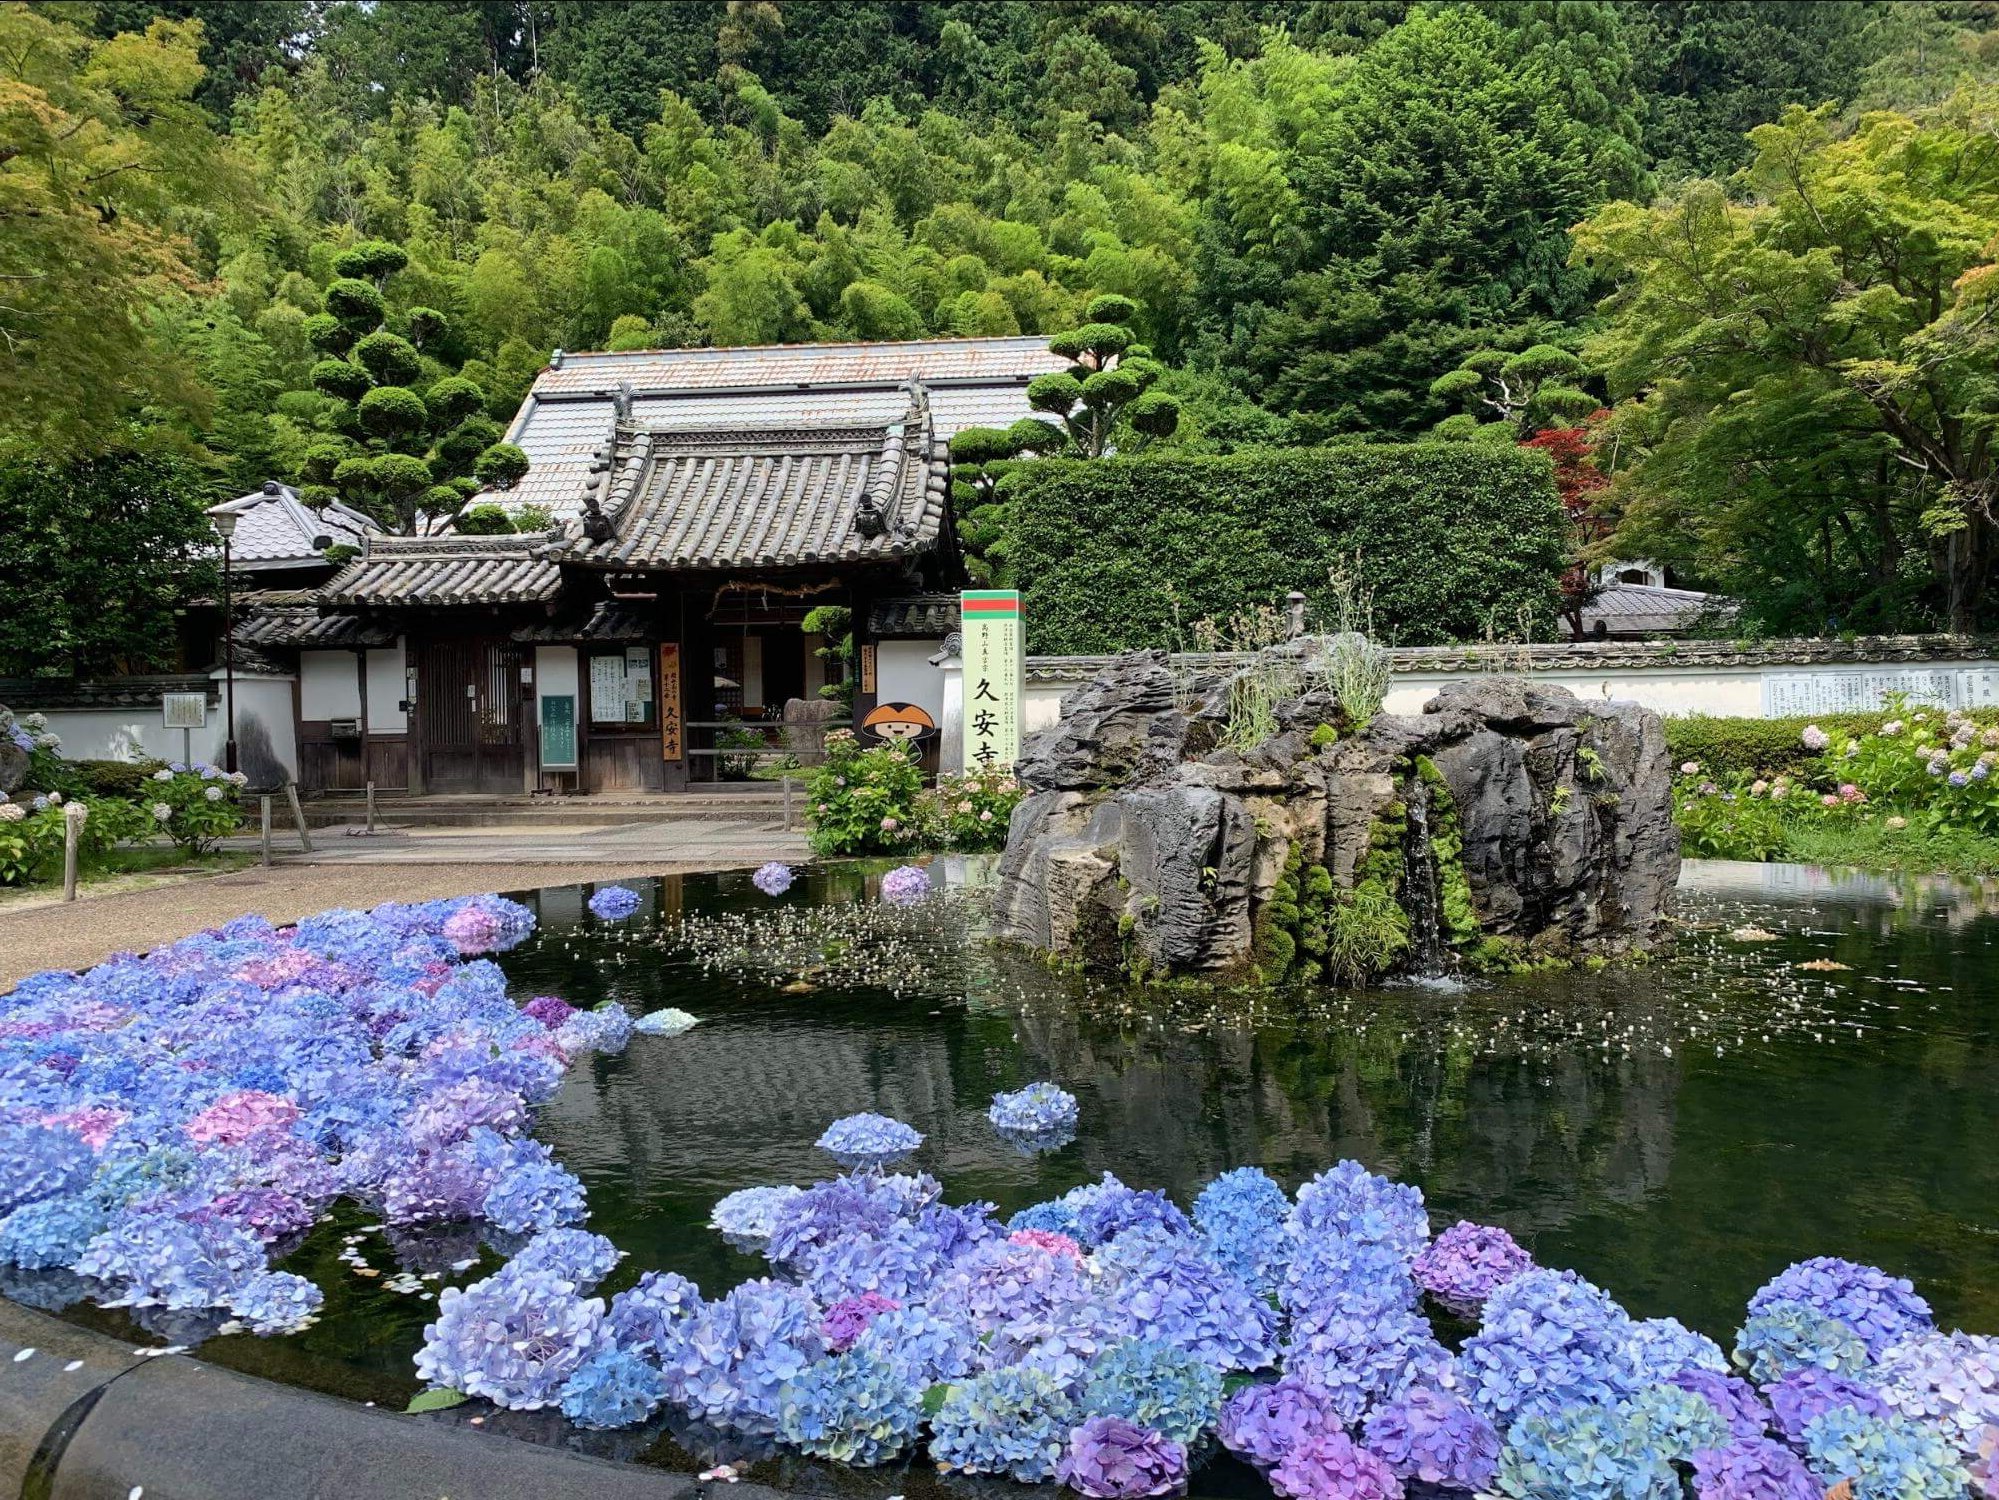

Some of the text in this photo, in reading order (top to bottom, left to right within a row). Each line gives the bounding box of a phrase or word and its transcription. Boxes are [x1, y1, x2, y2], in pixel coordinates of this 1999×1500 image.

[664, 706, 679, 754] 久安寺
[971, 678, 1000, 767] 久安寺
